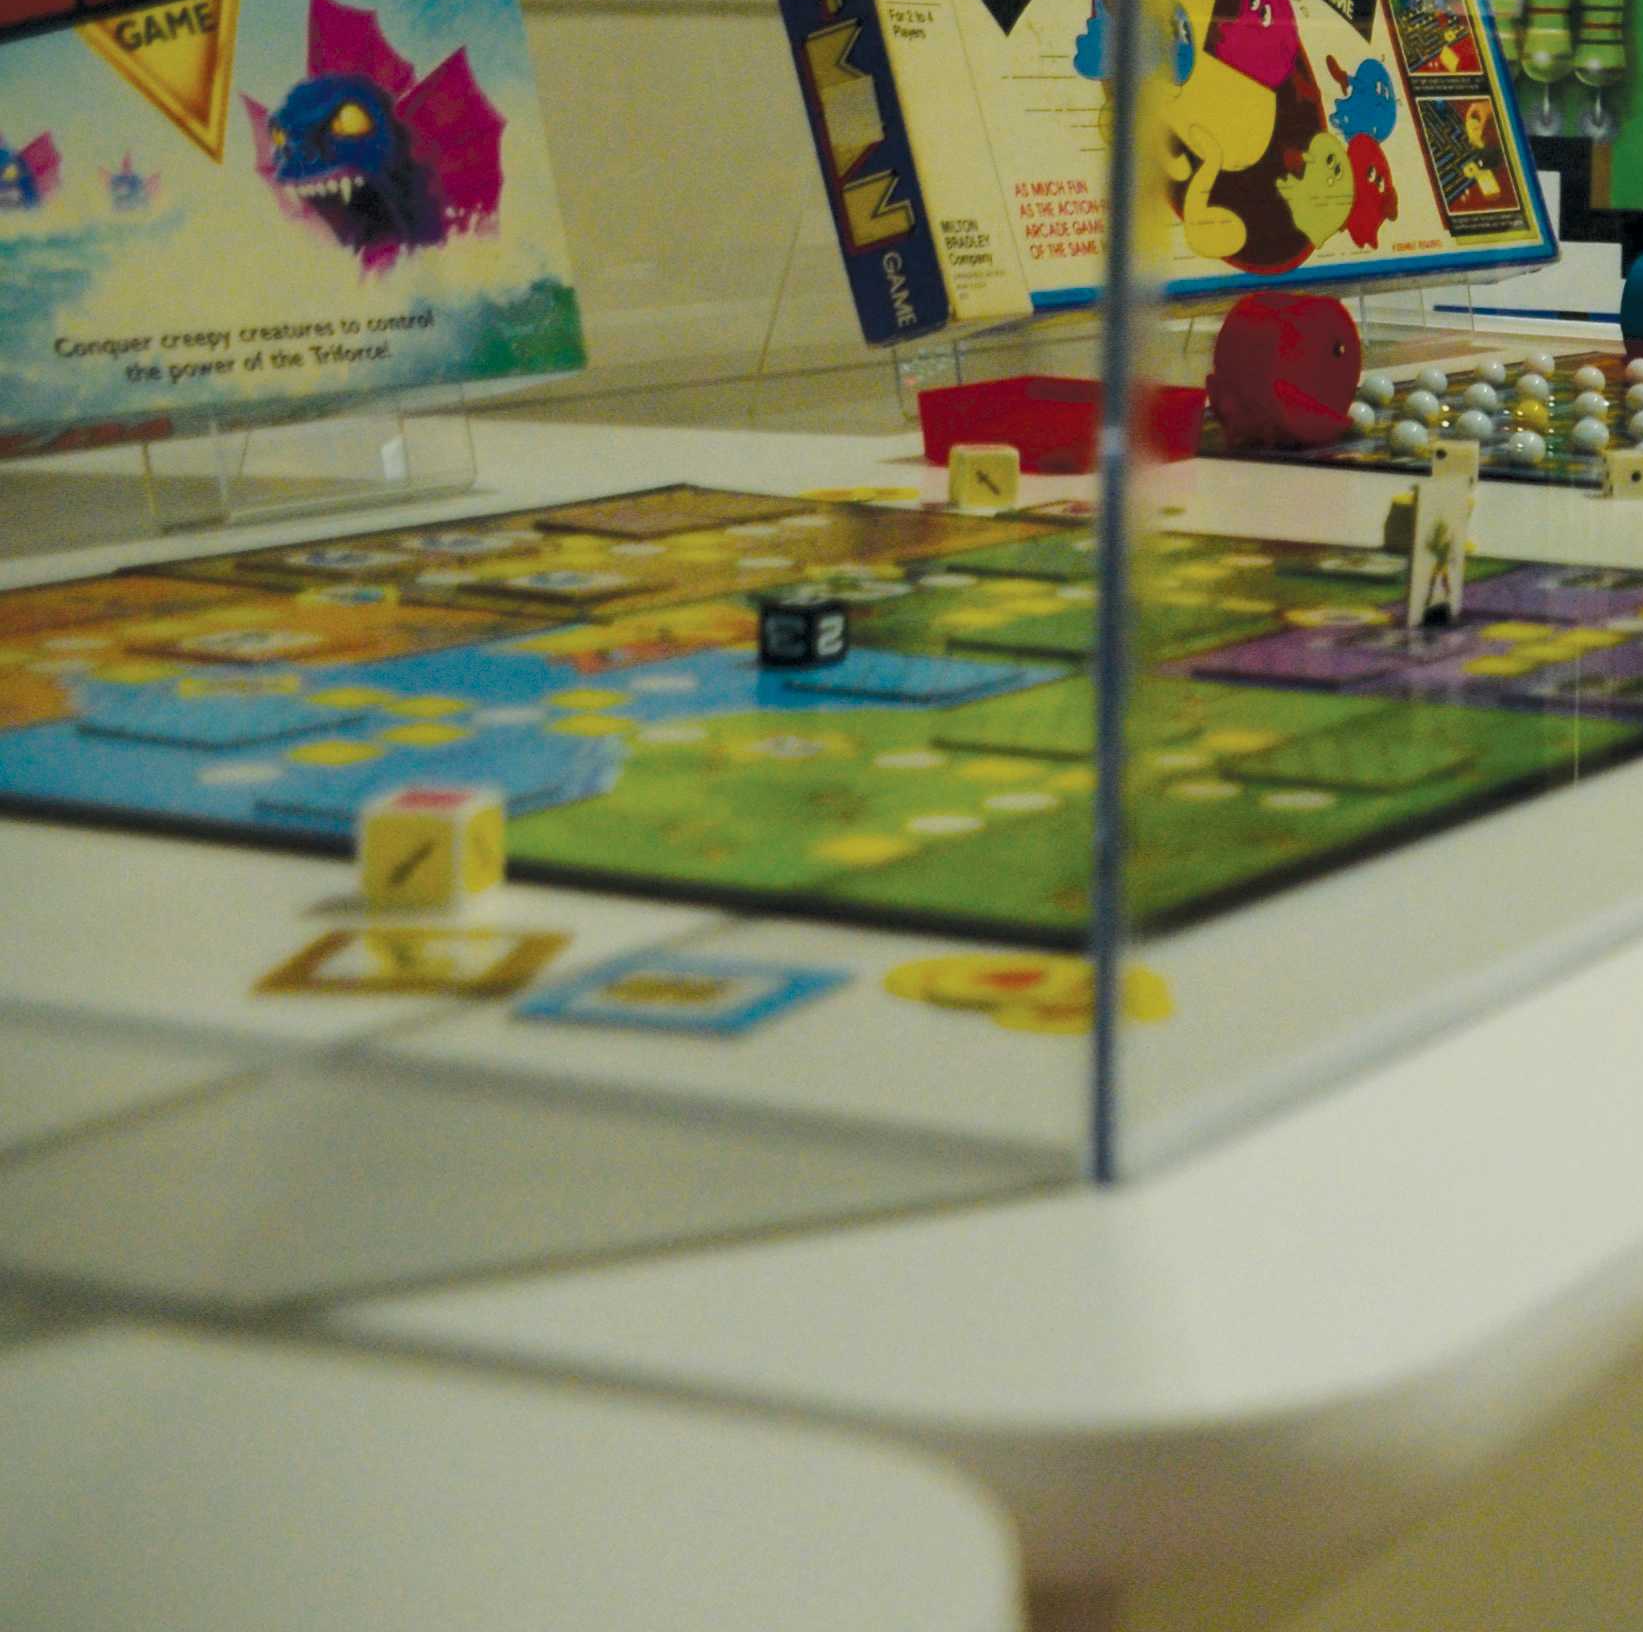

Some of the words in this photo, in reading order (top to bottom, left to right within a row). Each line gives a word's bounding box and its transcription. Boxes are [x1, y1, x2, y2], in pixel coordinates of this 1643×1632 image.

[113, 1, 219, 52] GAME
[893, 24, 927, 39] Players
[1015, 181, 1028, 197] AS
[1032, 181, 1063, 197] MUCH
[1067, 180, 1088, 194] FUN
[1020, 202, 1034, 218] AS
[1036, 201, 1053, 216] THE
[941, 220, 978, 234] MILTON
[1026, 221, 1068, 238] ARCADE
[945, 233, 989, 249] BRADLEY
[1030, 245, 1046, 260] OF
[1050, 243, 1067, 258] THE
[1072, 240, 1098, 256] SAME
[950, 252, 993, 267] Company
[882, 251, 917, 328] GAME
[54, 337, 152, 360] Conquer
[160, 329, 232, 352] creepy
[239, 319, 335, 343] creatures
[340, 317, 361, 336] to
[366, 310, 434, 333] control
[126, 364, 162, 383] the
[168, 358, 236, 384] power
[243, 350, 264, 371] of
[269, 350, 303, 369] the
